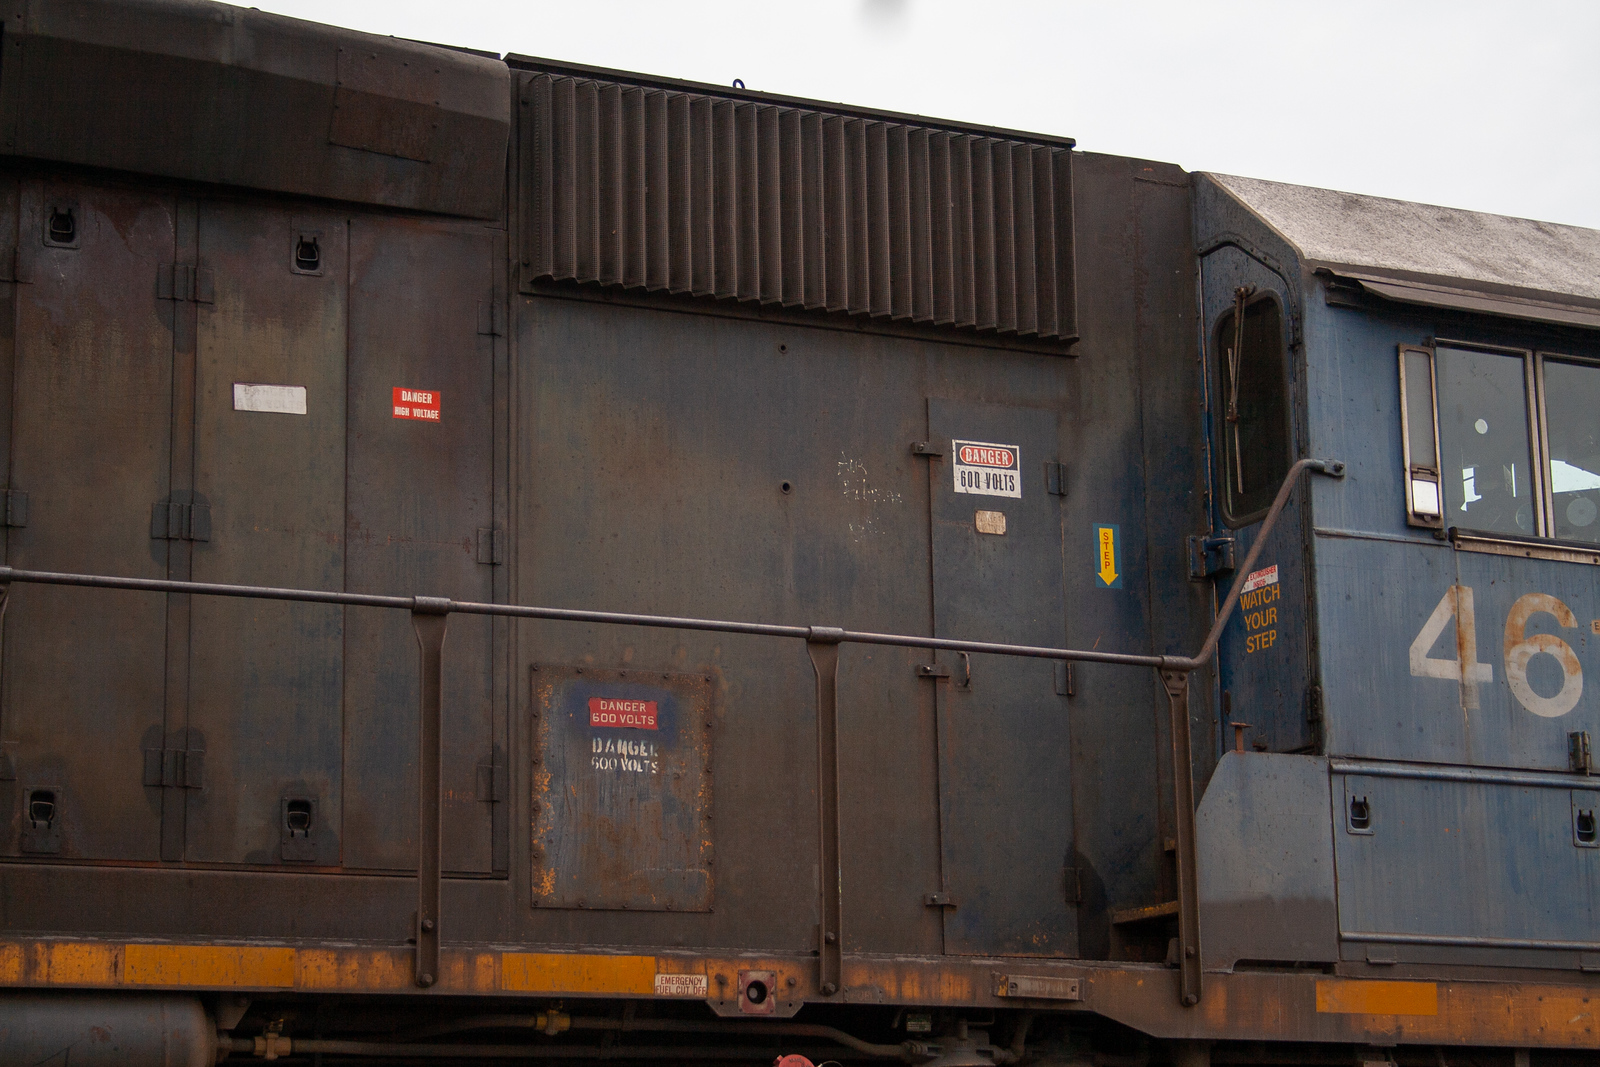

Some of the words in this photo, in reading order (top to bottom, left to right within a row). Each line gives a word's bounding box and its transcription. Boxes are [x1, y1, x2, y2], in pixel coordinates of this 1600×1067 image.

[401, 390, 433, 404] DANGER
[394, 406, 410, 417] HIGH
[412, 408, 439, 420] VOLTAGE
[964, 447, 1009, 466] DANGER
[960, 470, 980, 489] 600
[985, 472, 1015, 492] VOLTS
[1239, 583, 1280, 611] WATCH
[1244, 607, 1278, 631] YOUR
[1246, 629, 1277, 654] STEP
[600, 700, 646, 712] DANGER
[592, 713, 617, 723] 600
[619, 714, 655, 725] VOLTS
[620, 757, 659, 774] VOLTS
[660, 976, 703, 986] EMERGENCY
[655, 985, 672, 995] FUEL
[675, 985, 690, 995] CUT
[693, 986, 706, 995] OFF
